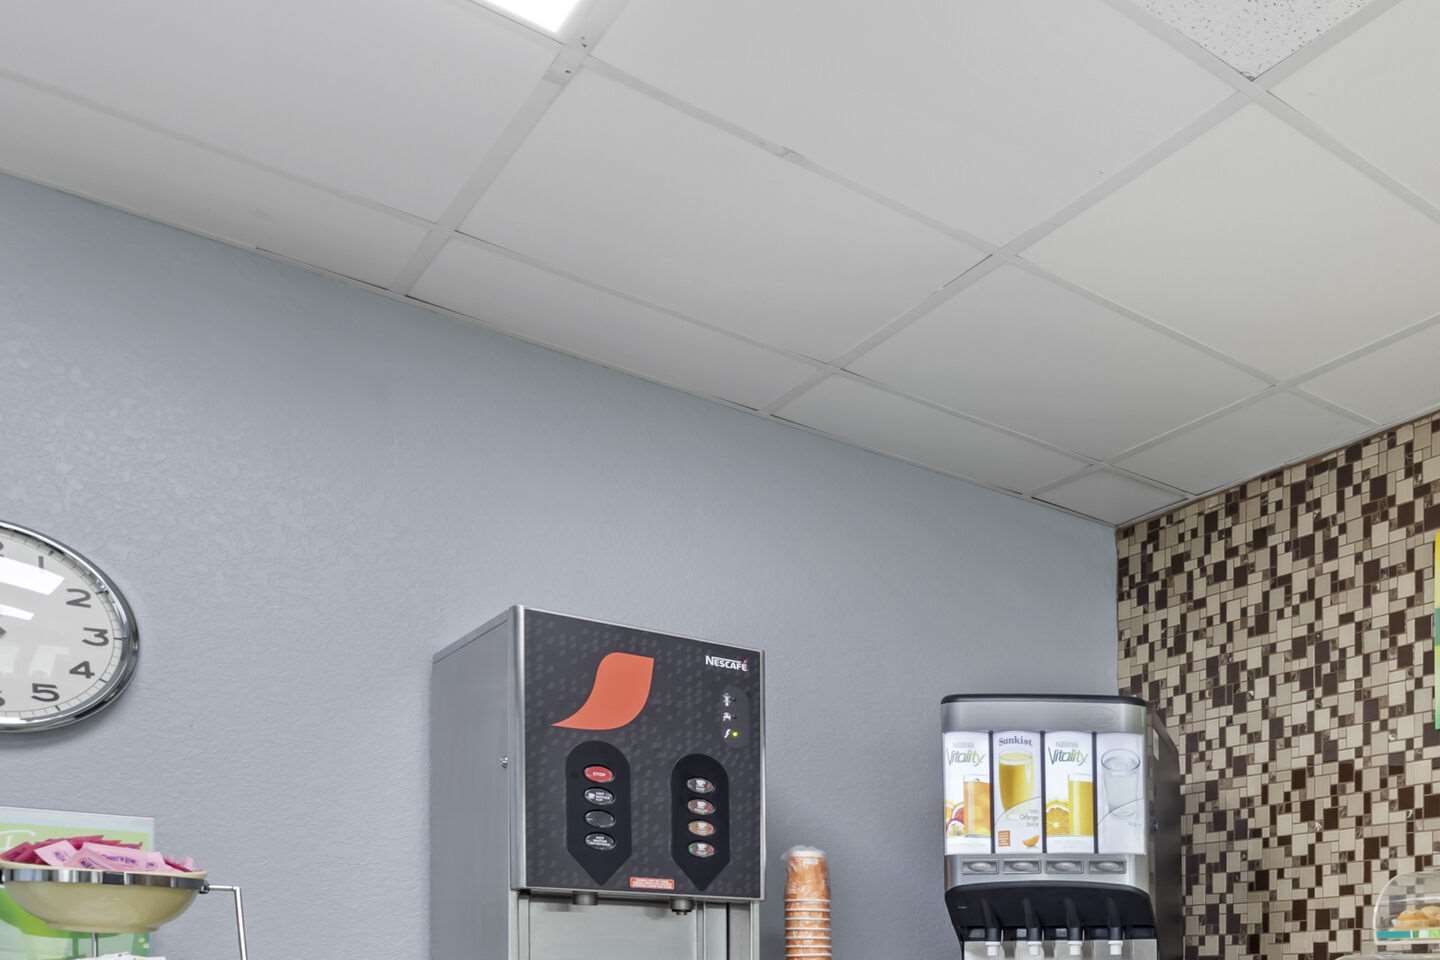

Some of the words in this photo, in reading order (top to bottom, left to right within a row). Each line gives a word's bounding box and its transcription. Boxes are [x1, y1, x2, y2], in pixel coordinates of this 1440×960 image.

[66, 588, 92, 608] 2
[82, 627, 110, 646] 3
[69, 660, 95, 679] 4
[31, 683, 60, 702] 5
[998, 736, 1032, 746] Sunkist
[1048, 746, 1089, 767] Vitality
